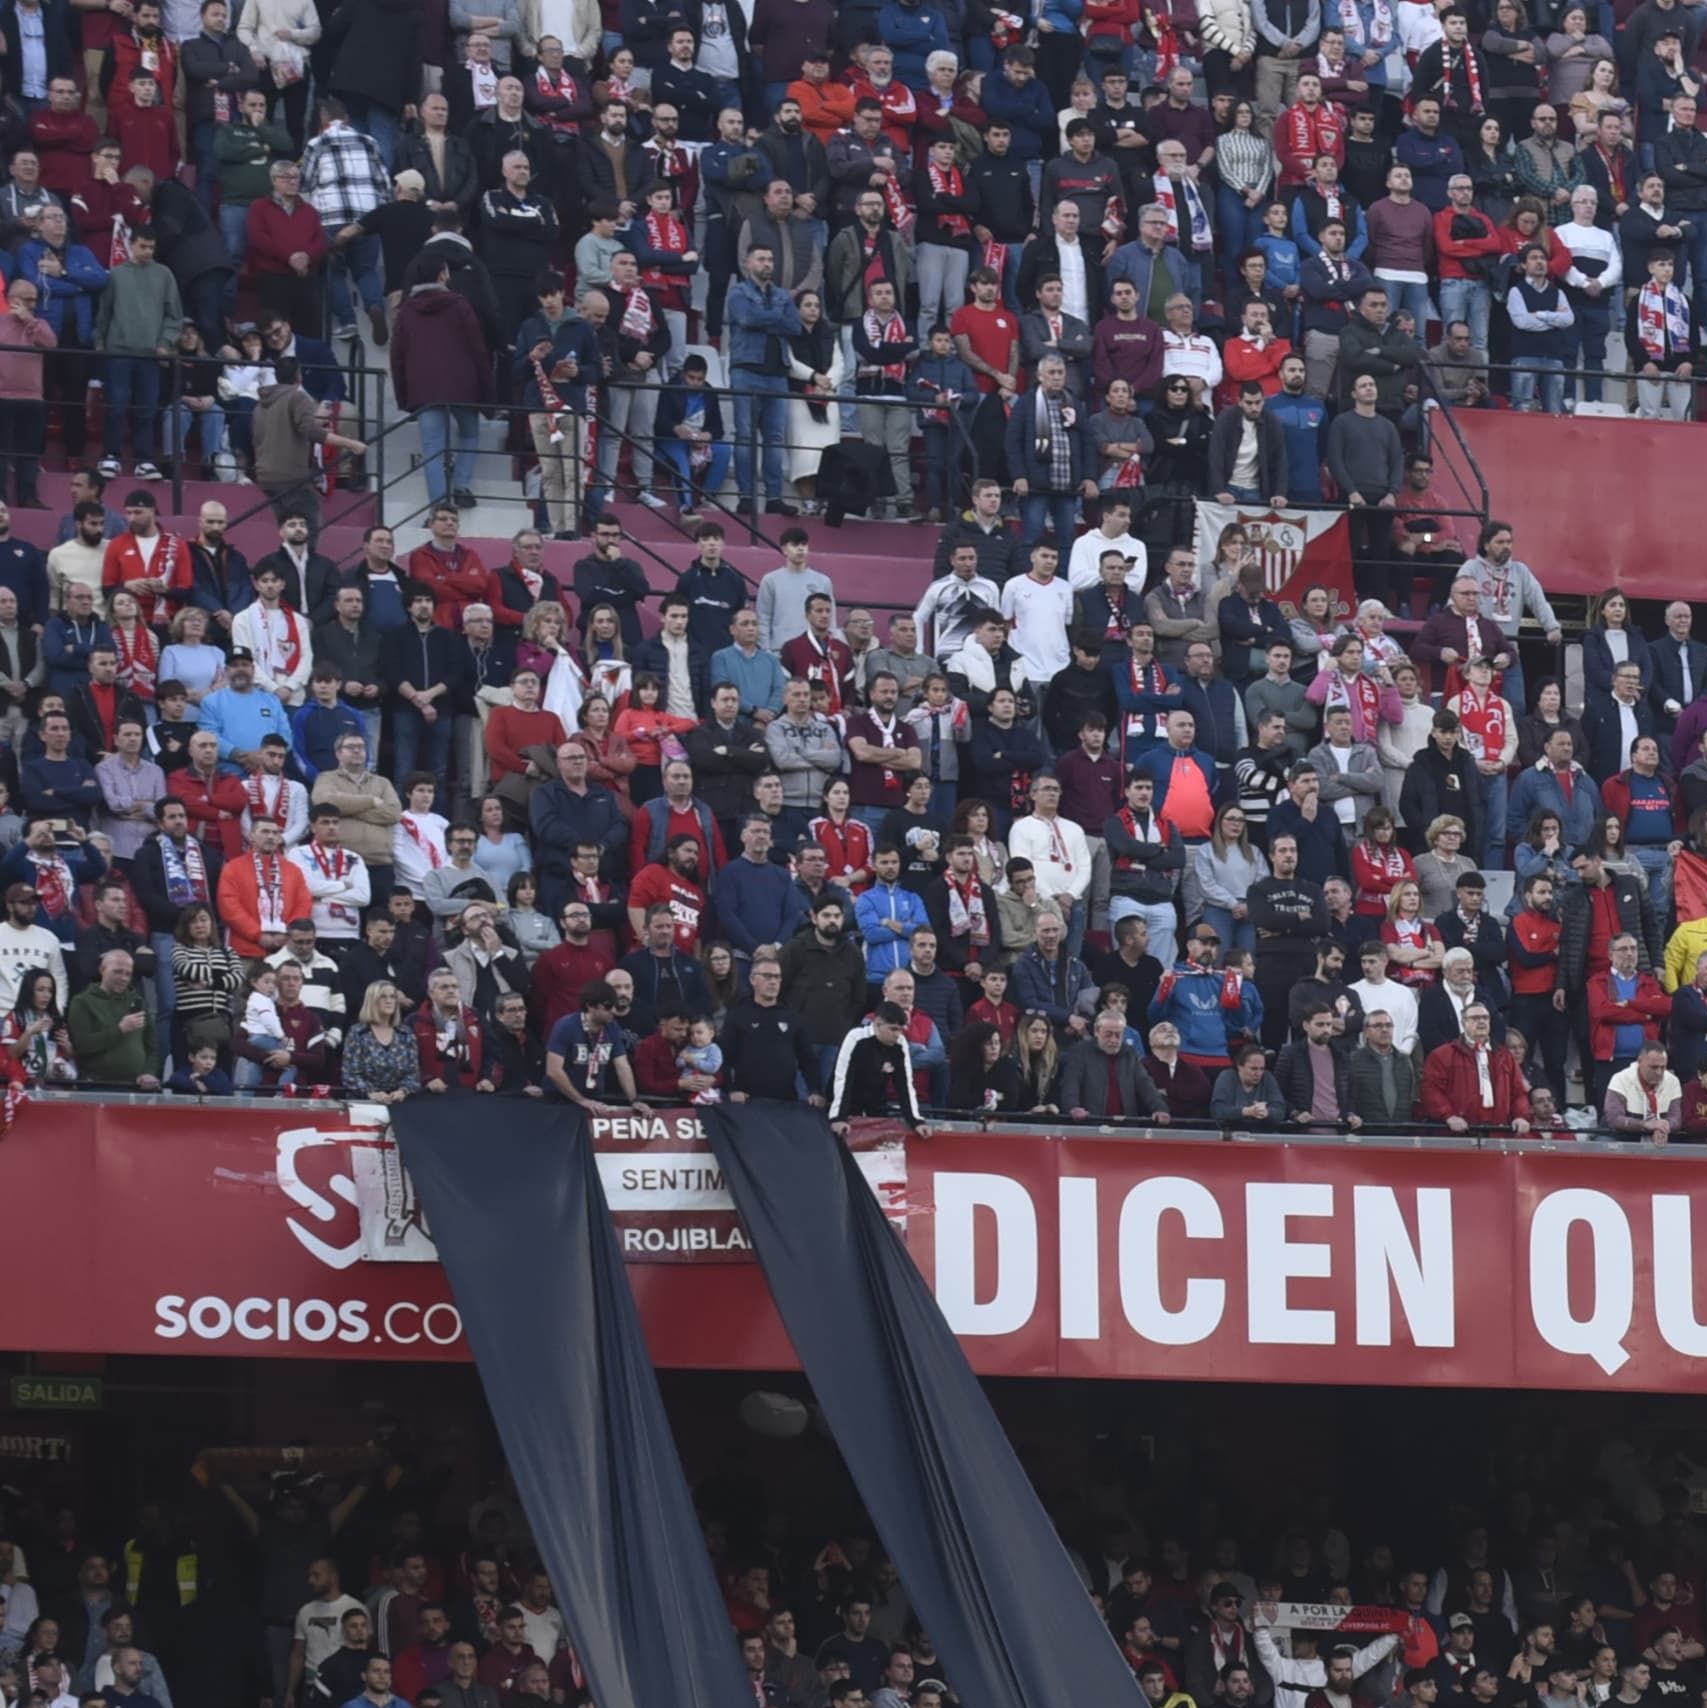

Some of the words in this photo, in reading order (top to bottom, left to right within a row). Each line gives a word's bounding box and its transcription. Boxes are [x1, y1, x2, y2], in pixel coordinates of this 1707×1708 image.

[624, 1227, 753, 1252] ROJIBLA
[933, 1171, 1455, 1349] DICEN
[155, 1294, 462, 1345] SOCIOS.co
[17, 1383, 96, 1404] SALIDA
[1303, 1606, 1330, 1617] POR
[1332, 1606, 1347, 1617] LA
